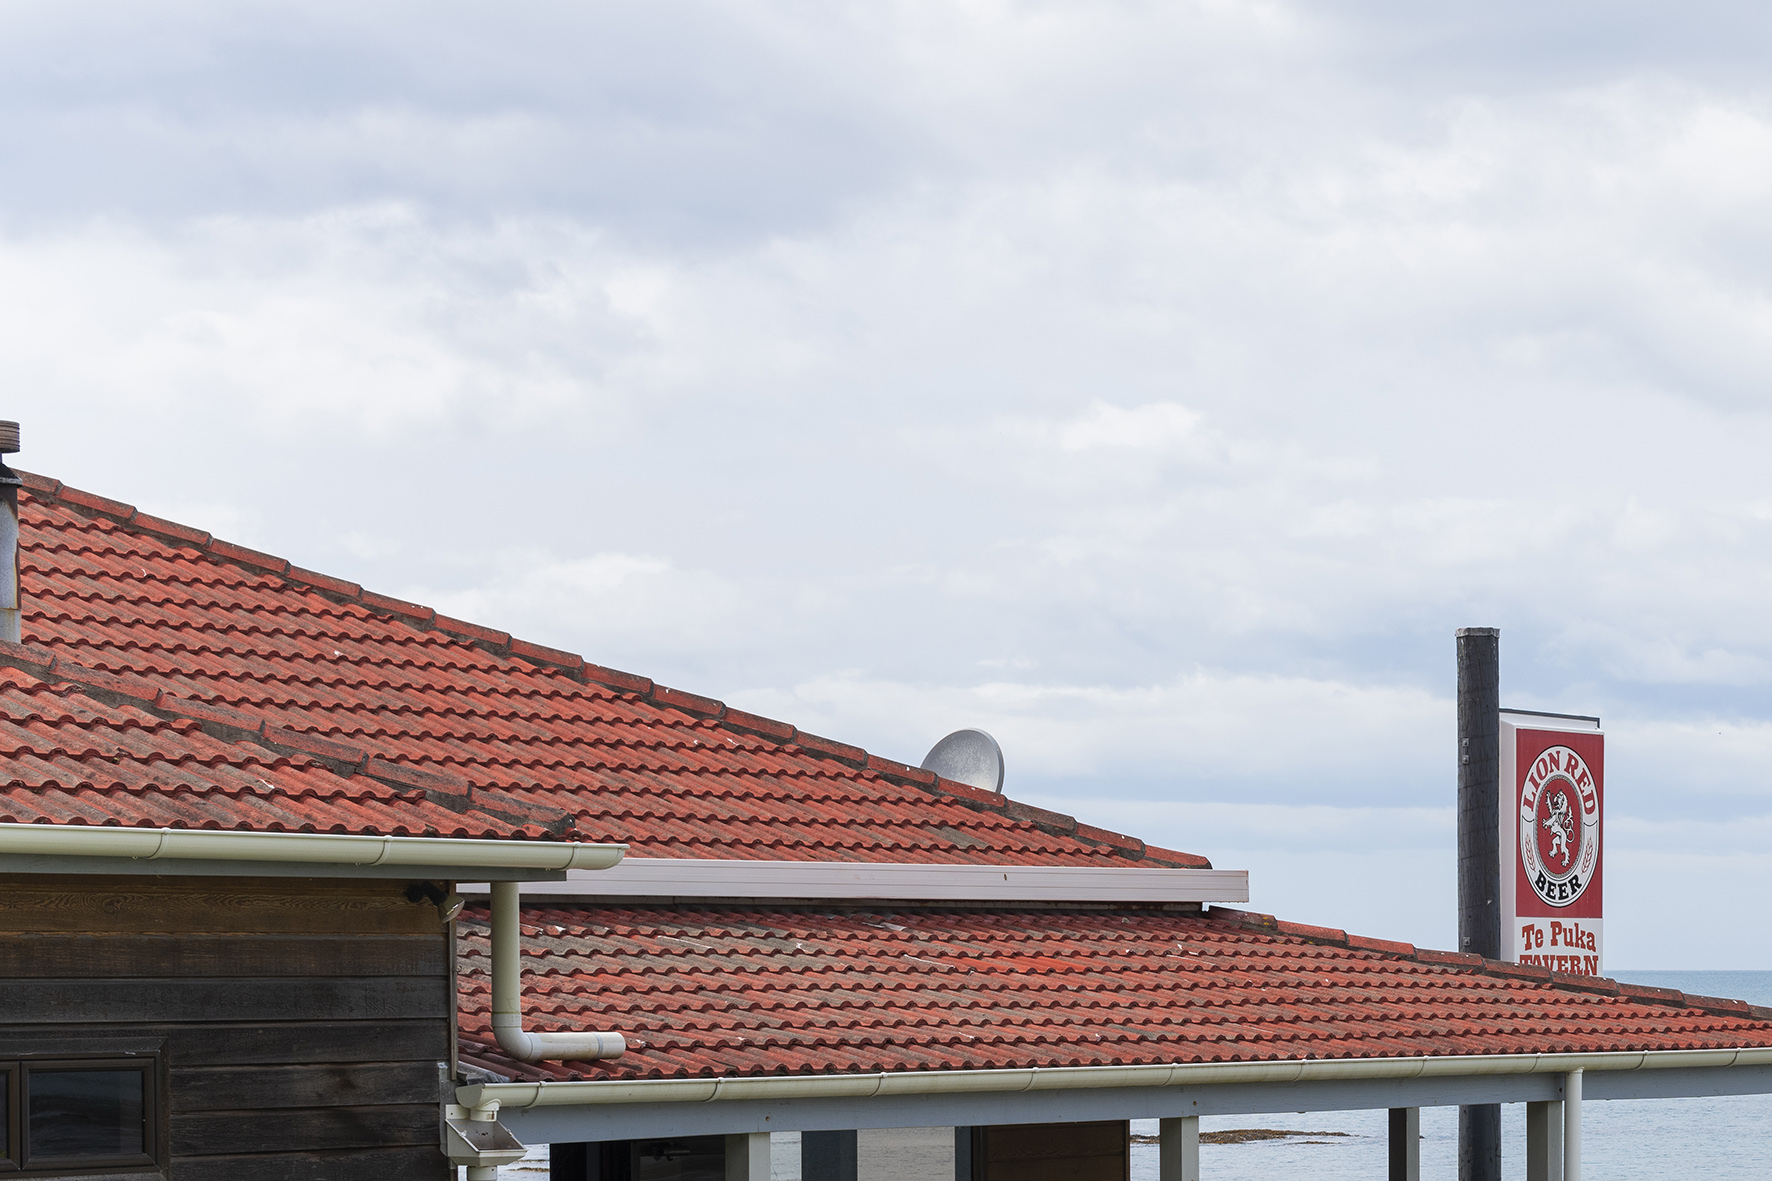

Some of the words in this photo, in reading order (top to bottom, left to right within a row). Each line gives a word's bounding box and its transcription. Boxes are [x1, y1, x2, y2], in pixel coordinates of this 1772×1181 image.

[1523, 750, 1561, 812] LION
[1564, 753, 1596, 816] RED
[1534, 870, 1583, 901] BEER
[1521, 923, 1544, 951] Te
[1550, 920, 1597, 952] Puka
